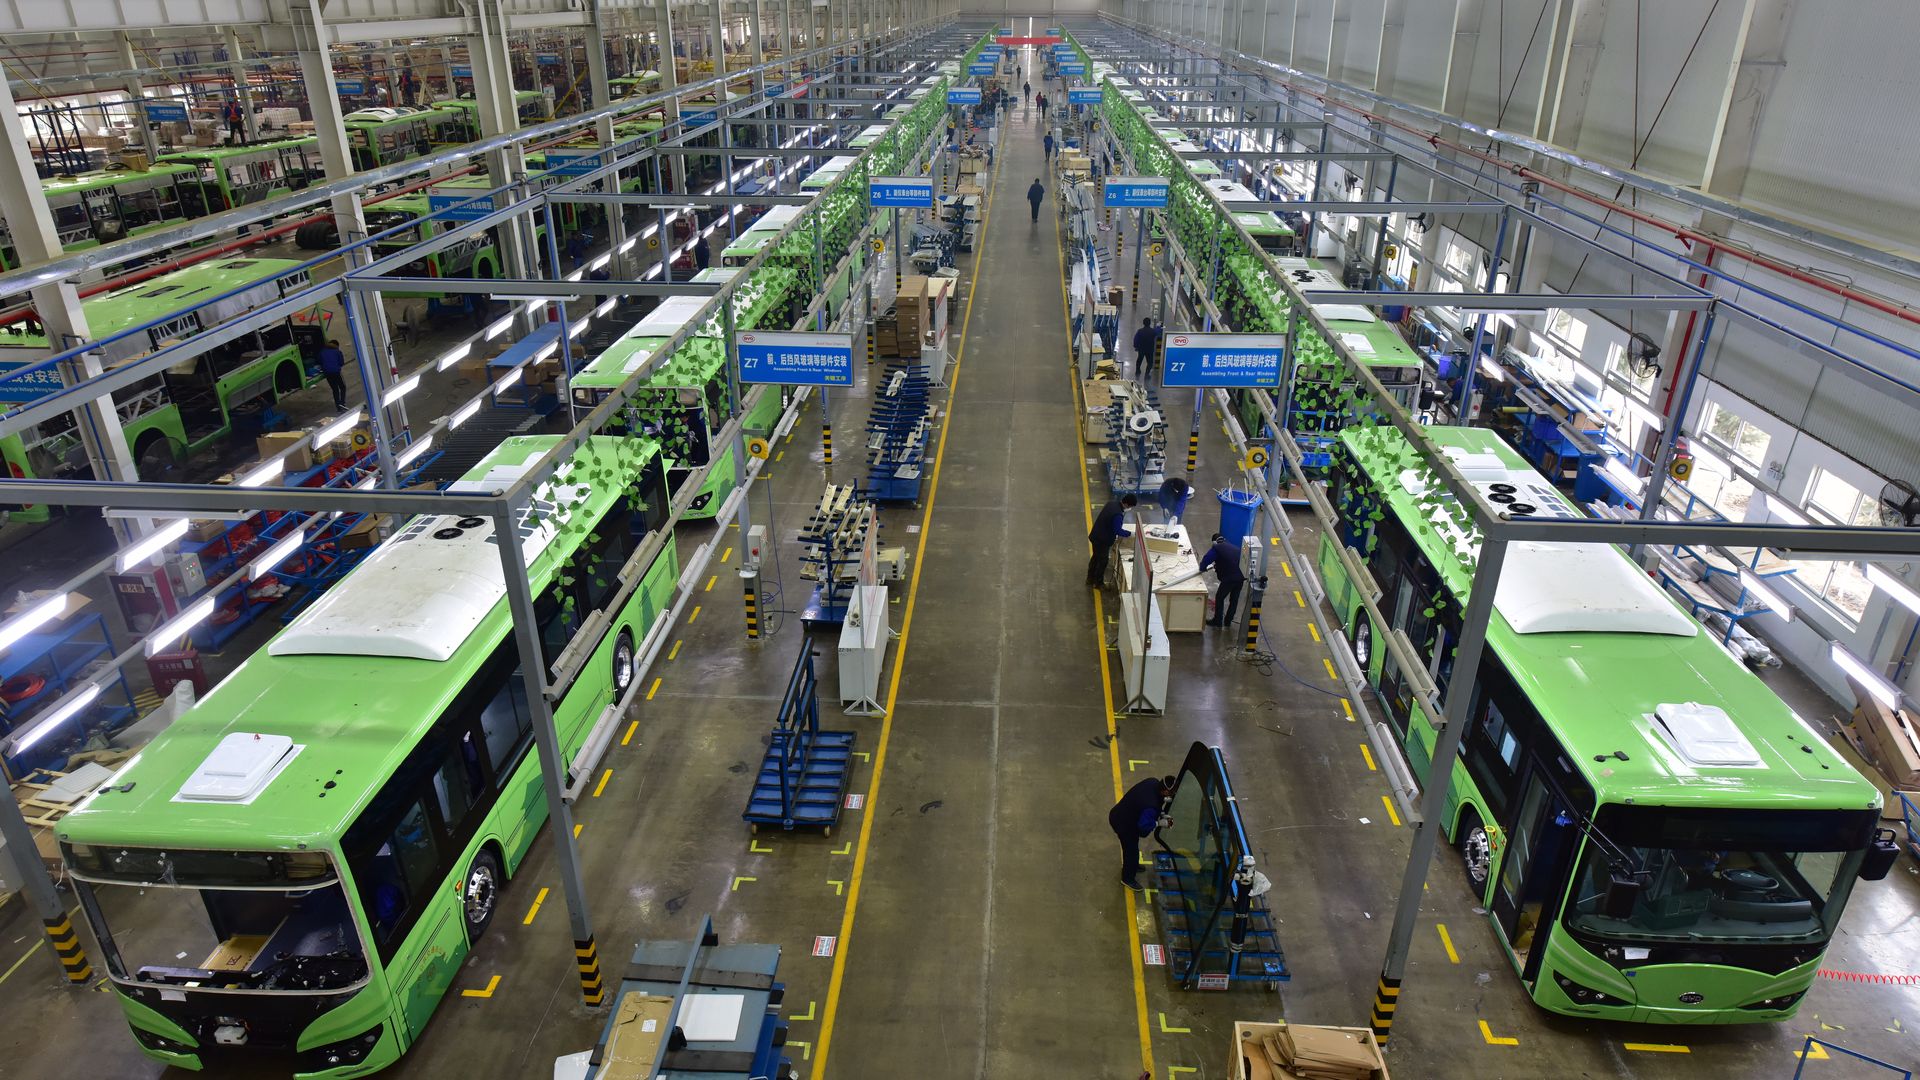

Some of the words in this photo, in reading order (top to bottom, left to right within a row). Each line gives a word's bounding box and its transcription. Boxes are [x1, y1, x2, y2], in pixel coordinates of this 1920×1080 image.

[744, 358, 758, 368] Z7
[767, 353, 847, 367] 前、后挡风玻璃等部件安装
[1202, 355, 1277, 367] 前、后挡风玻璃等部件安装
[1171, 362, 1186, 372] Z7
